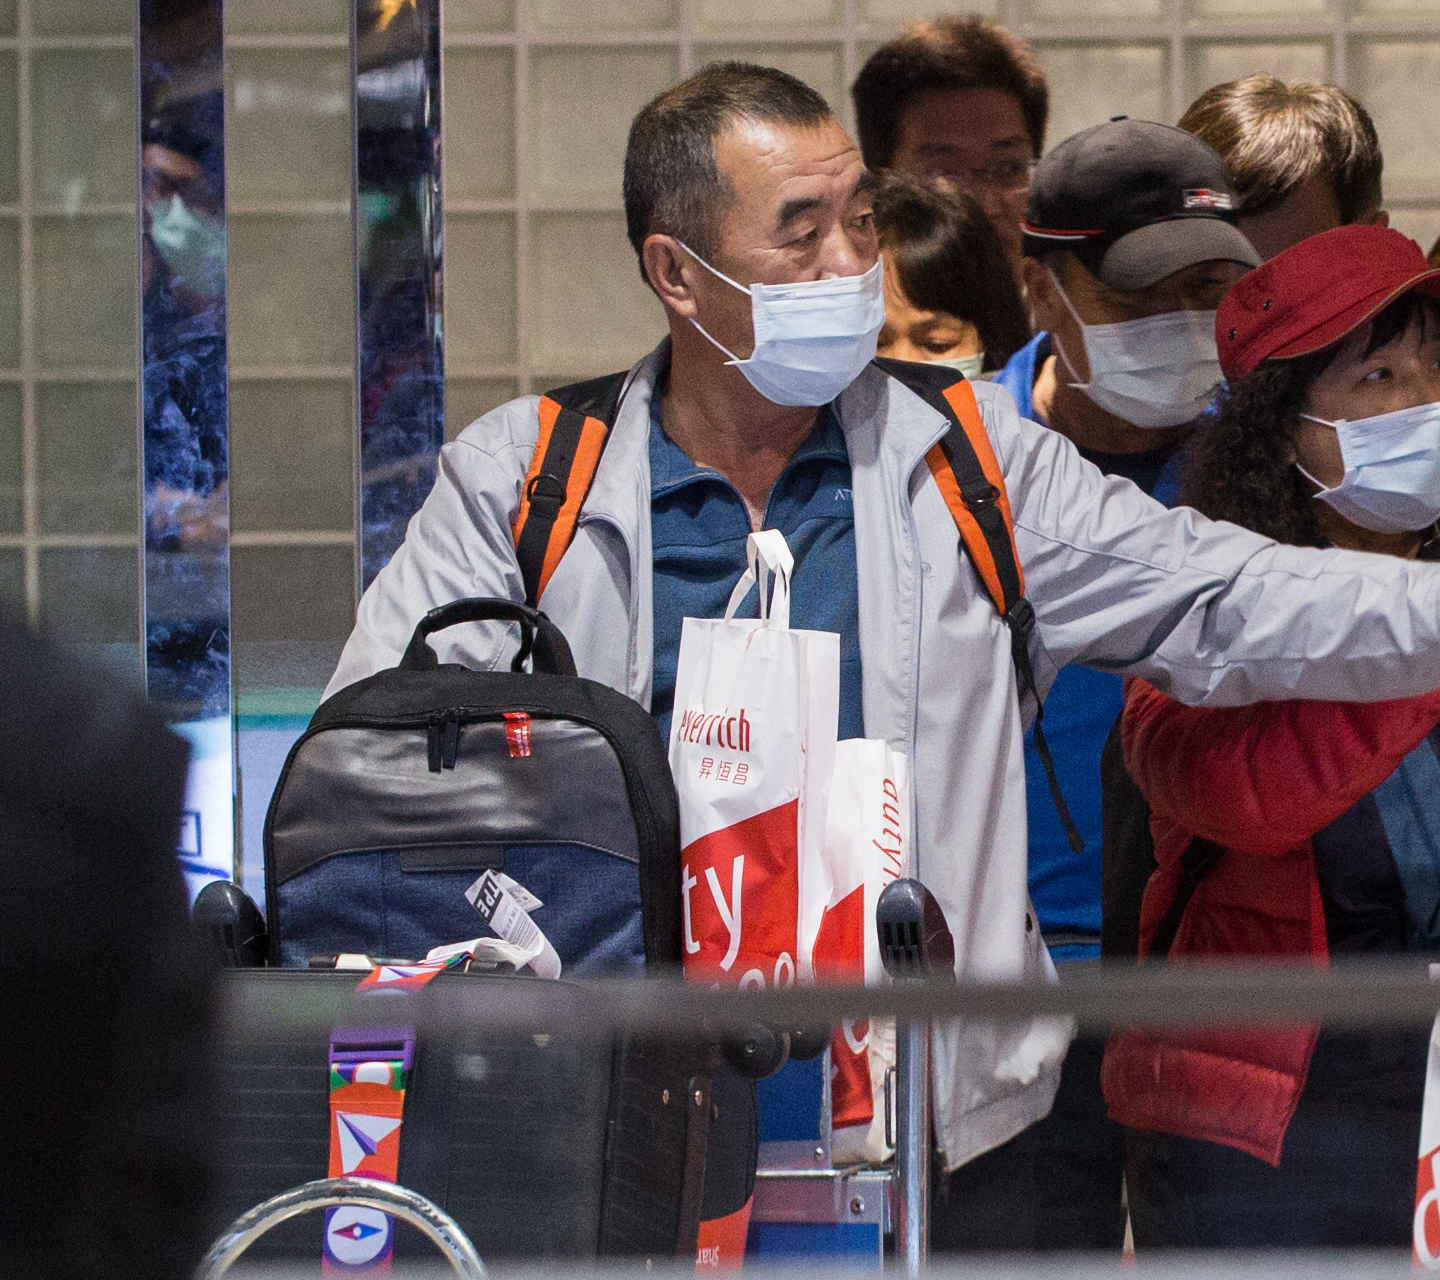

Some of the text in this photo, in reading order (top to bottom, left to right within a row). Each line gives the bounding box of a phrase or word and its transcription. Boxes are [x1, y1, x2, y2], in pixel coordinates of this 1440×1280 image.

[677, 707, 751, 753] everrich
[476, 880, 501, 919] TPE
[682, 854, 745, 972] ty
